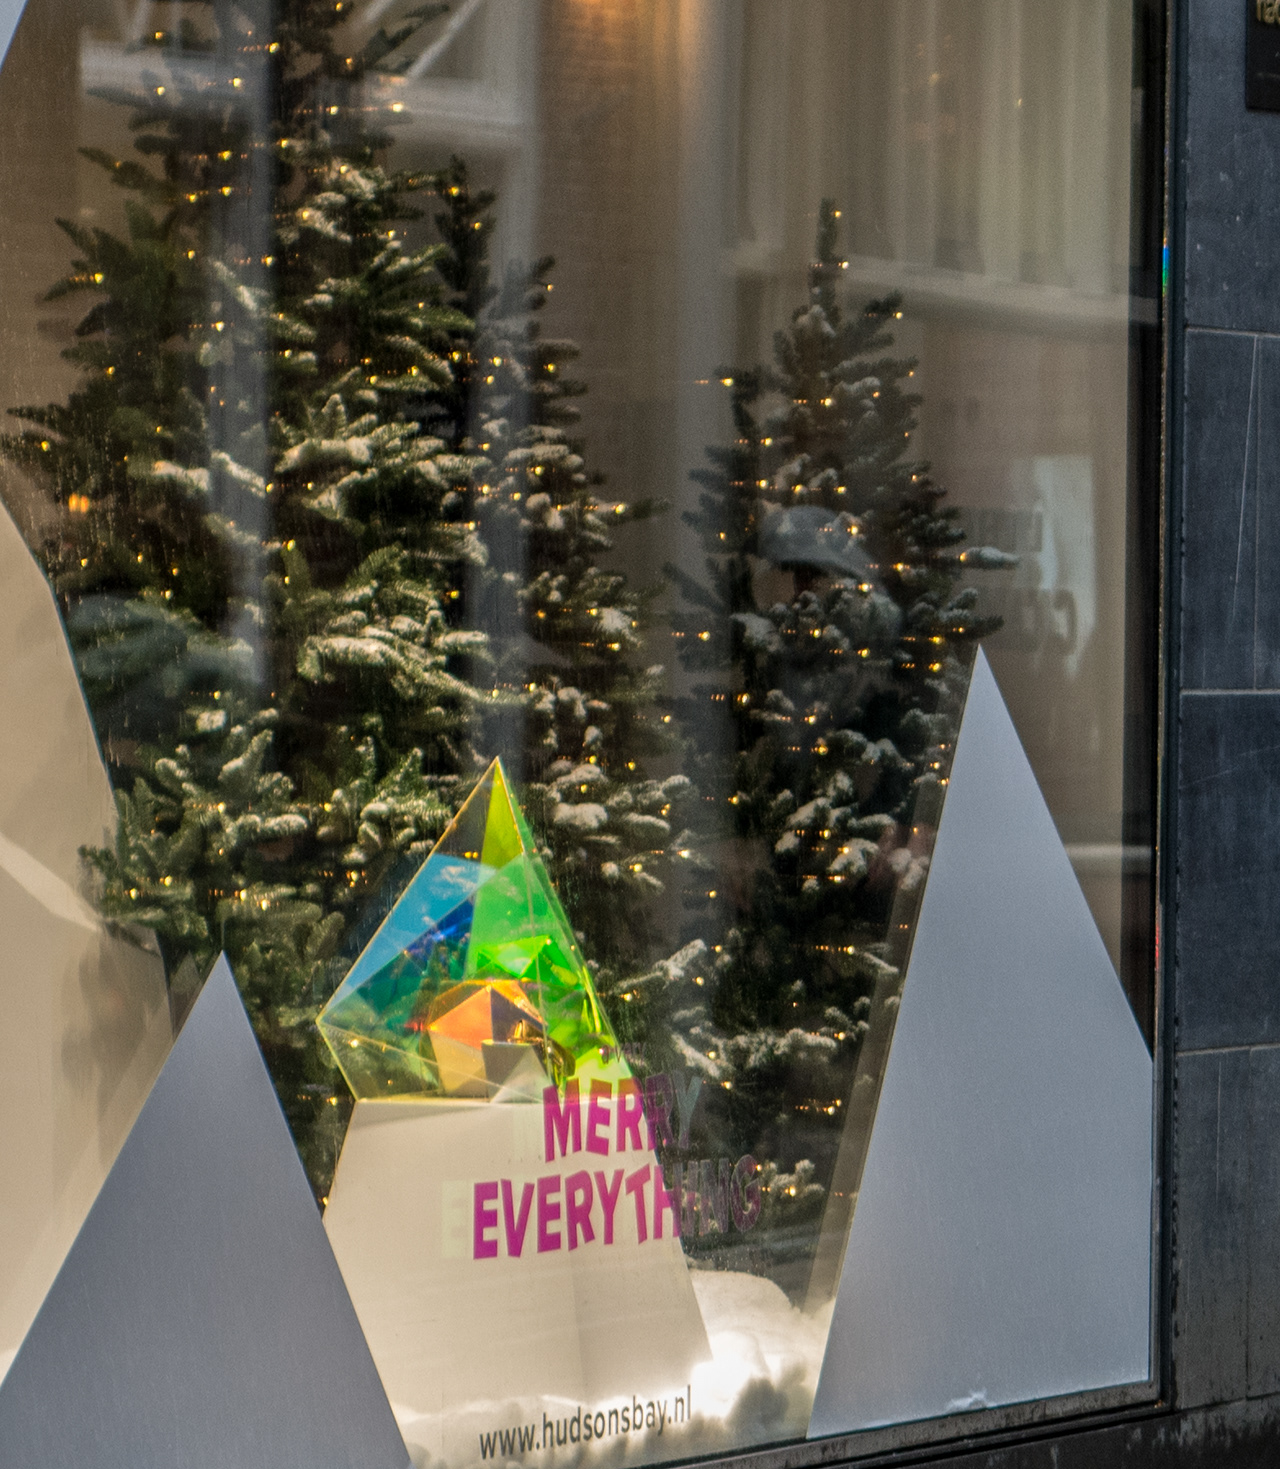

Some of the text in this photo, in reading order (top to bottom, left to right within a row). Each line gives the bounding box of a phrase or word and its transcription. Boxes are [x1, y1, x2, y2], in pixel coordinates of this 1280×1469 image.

[542, 1070, 702, 1163] MERRY
[473, 1154, 761, 1260] EVERYTHING
[479, 1385, 691, 1460] www.hudsonsbay.nl
